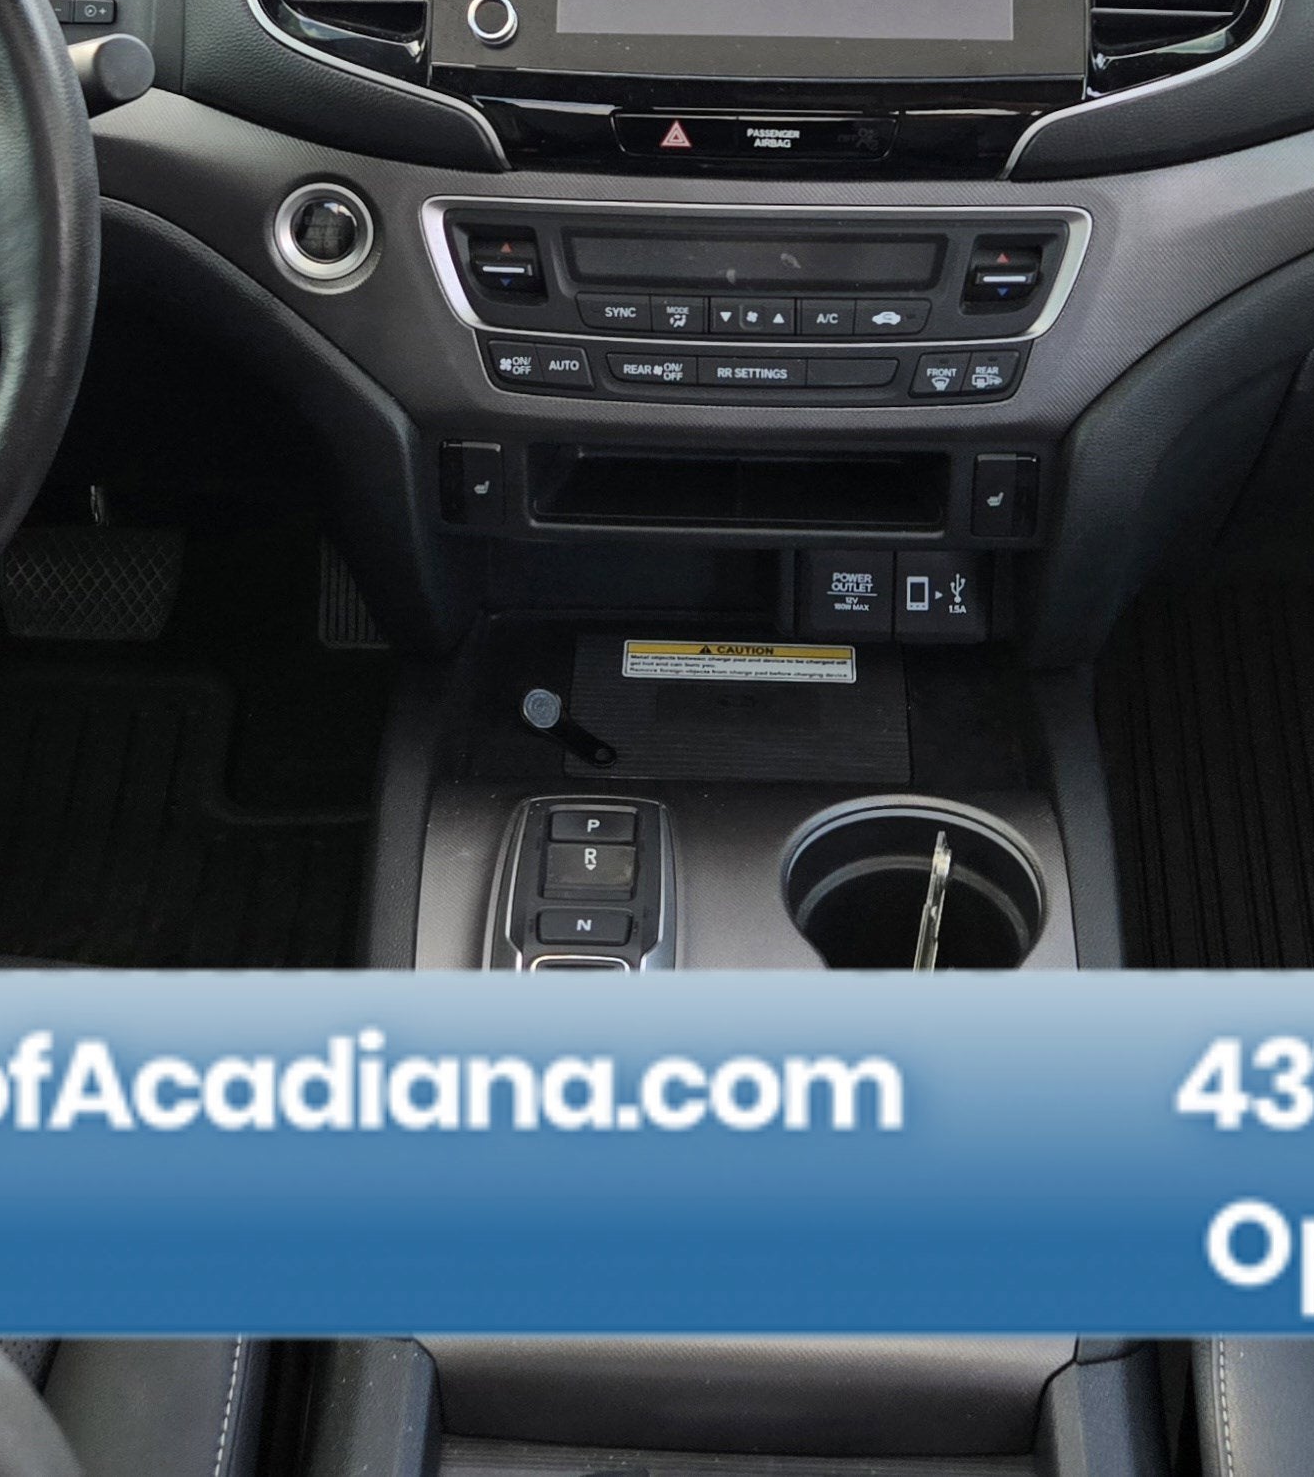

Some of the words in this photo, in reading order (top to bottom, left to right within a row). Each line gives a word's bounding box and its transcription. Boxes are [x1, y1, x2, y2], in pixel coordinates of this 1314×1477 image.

[746, 127, 800, 139] PASSENGER
[753, 138, 792, 148] AIRBAG
[605, 306, 637, 318] SYNC
[666, 306, 689, 315] MODE
[816, 312, 838, 324] A/C
[512, 356, 531, 366] ON/
[549, 360, 580, 371] AUTO
[513, 365, 532, 375] OFF
[623, 363, 652, 375] REAR
[663, 362, 683, 373] ON/
[717, 367, 733, 378] RR
[734, 367, 788, 380] SETTINGS
[926, 368, 957, 377] FRONT
[975, 366, 999, 375] REAR
[663, 371, 683, 381] OFF
[832, 572, 872, 583] POWER
[831, 582, 873, 593] OUTLET
[717, 646, 774, 655] CAUTION
[586, 819, 600, 833] P
[584, 848, 598, 865] R
[576, 919, 593, 932] N
